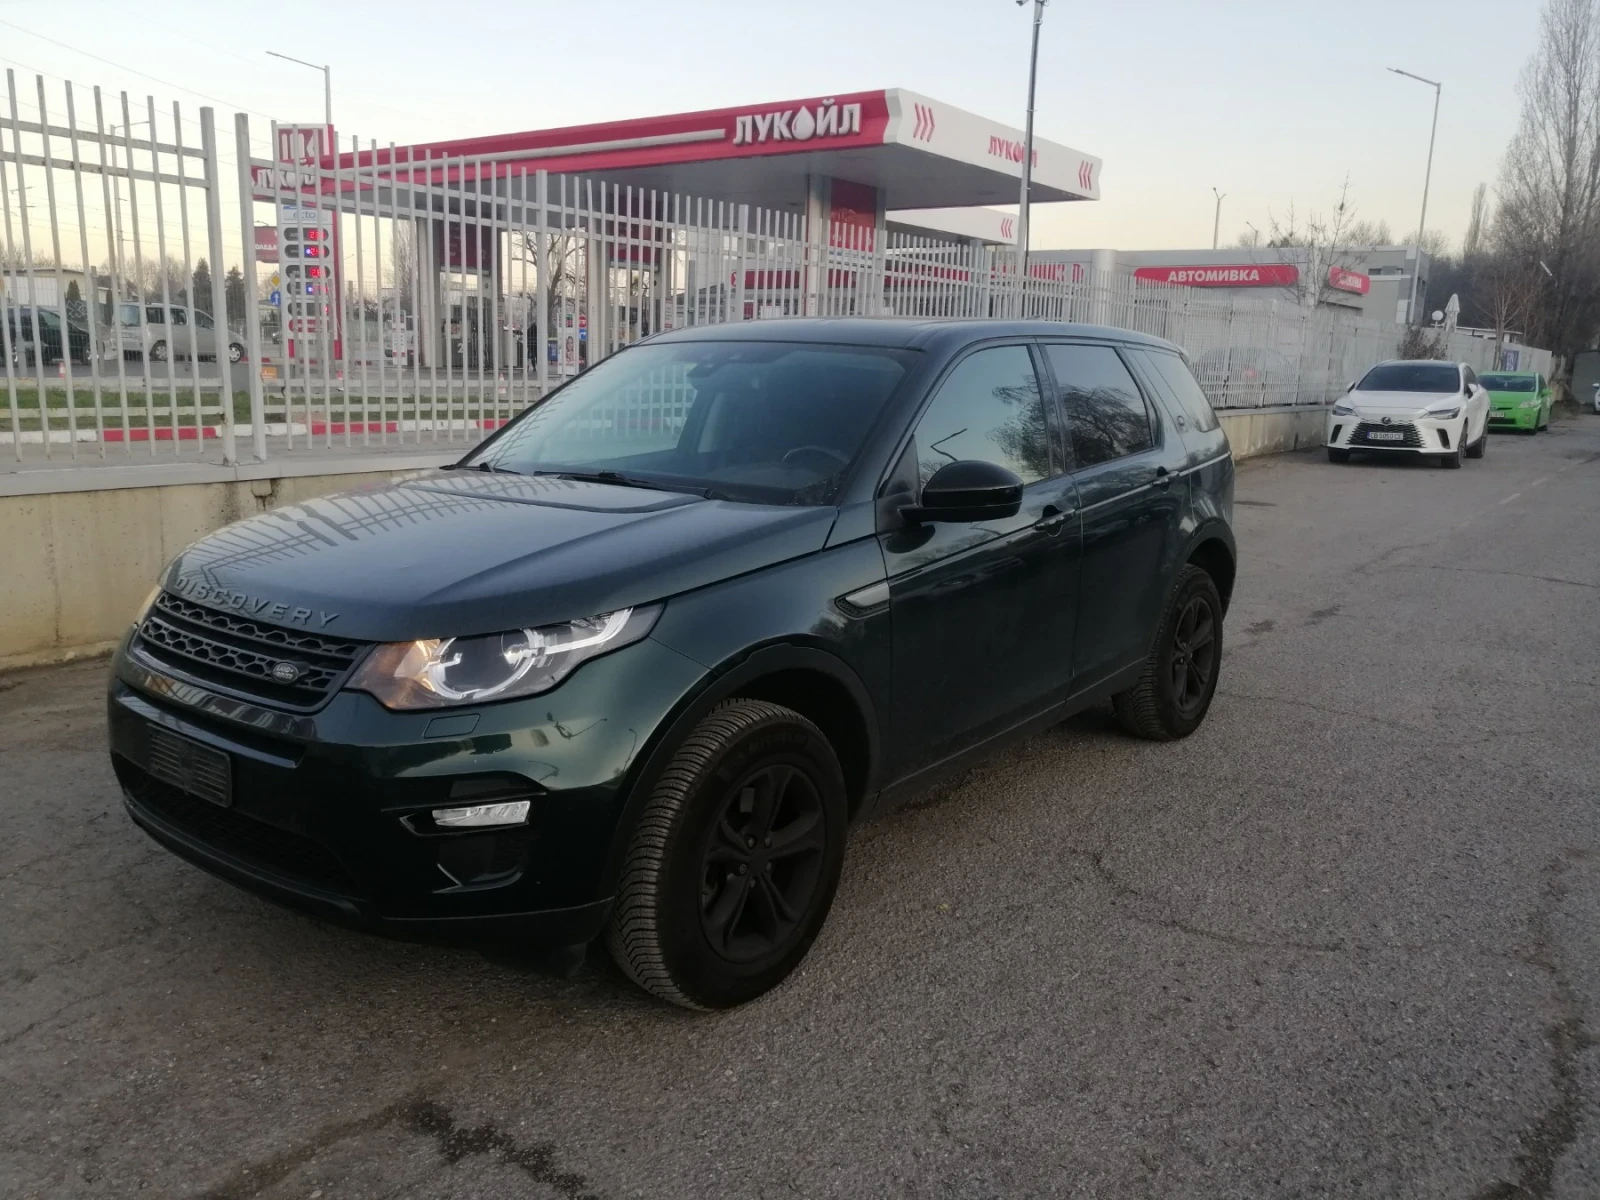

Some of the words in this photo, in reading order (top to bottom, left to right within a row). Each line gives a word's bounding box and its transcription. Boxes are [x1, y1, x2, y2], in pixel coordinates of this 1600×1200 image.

[732, 97, 861, 145] ЛУКОЙЛ
[1167, 269, 1261, 282] АВТОМИВКА
[174, 575, 341, 629] DISCOVERY
[275, 665, 292, 673] LAND
